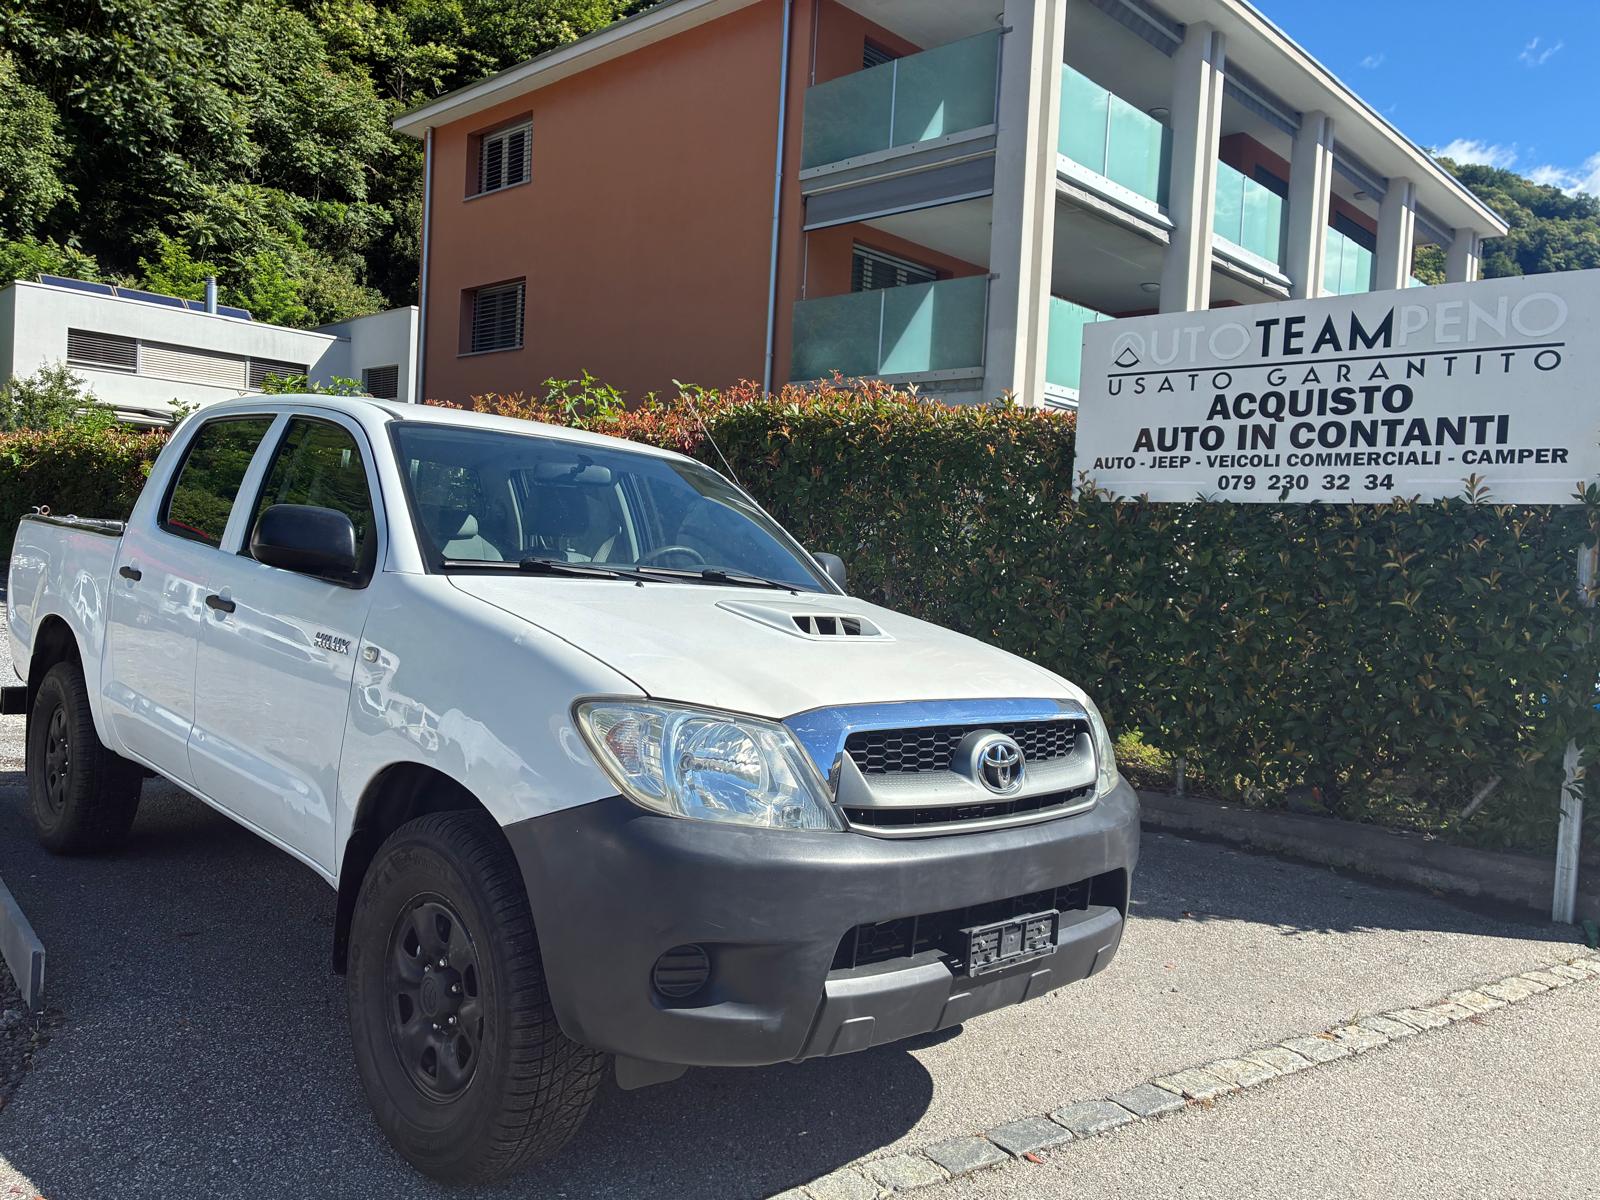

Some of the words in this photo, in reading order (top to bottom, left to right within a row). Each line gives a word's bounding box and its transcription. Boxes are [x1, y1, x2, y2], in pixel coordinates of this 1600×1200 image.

[1108, 372, 1233, 396] USATO
[1266, 350, 1562, 387] GARANTITO
[1206, 383, 1414, 422] ACQUISTO
[1132, 425, 1226, 453] AUTO
[1237, 423, 1277, 450] IN
[1289, 414, 1510, 450] CONTANTI
[1093, 456, 1136, 469] AUTO
[1149, 455, 1191, 469] JEEP
[1206, 453, 1281, 468] VEICOLI
[1286, 450, 1441, 468] COMMERCIALI
[1461, 448, 1569, 465] CAMPER
[1217, 475, 1256, 490] 079
[1267, 474, 1309, 490] 230
[1321, 474, 1351, 490] 32
[1364, 474, 1395, 490] 34
